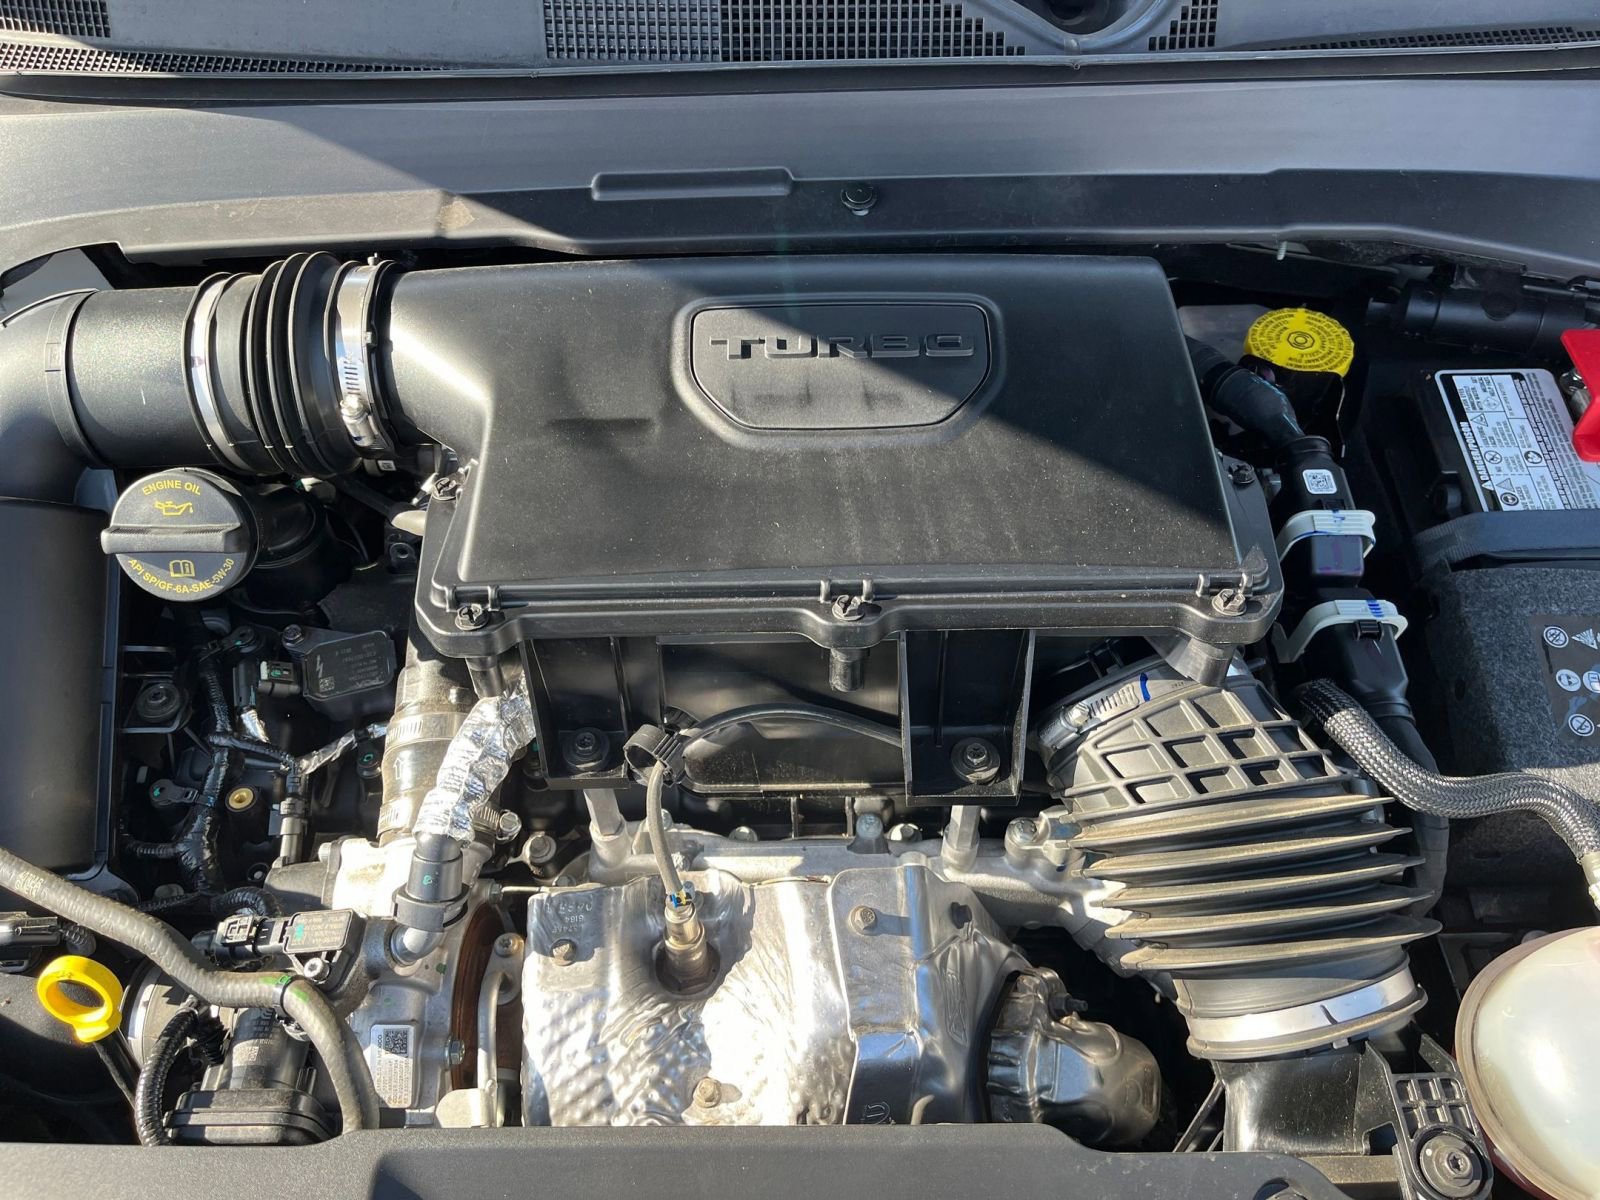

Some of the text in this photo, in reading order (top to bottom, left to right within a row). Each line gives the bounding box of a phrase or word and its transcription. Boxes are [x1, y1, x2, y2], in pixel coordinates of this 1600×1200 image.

[709, 334, 975, 360] TURBO
[142, 480, 201, 496] ENGINE OIL
[128, 559, 145, 575] API
